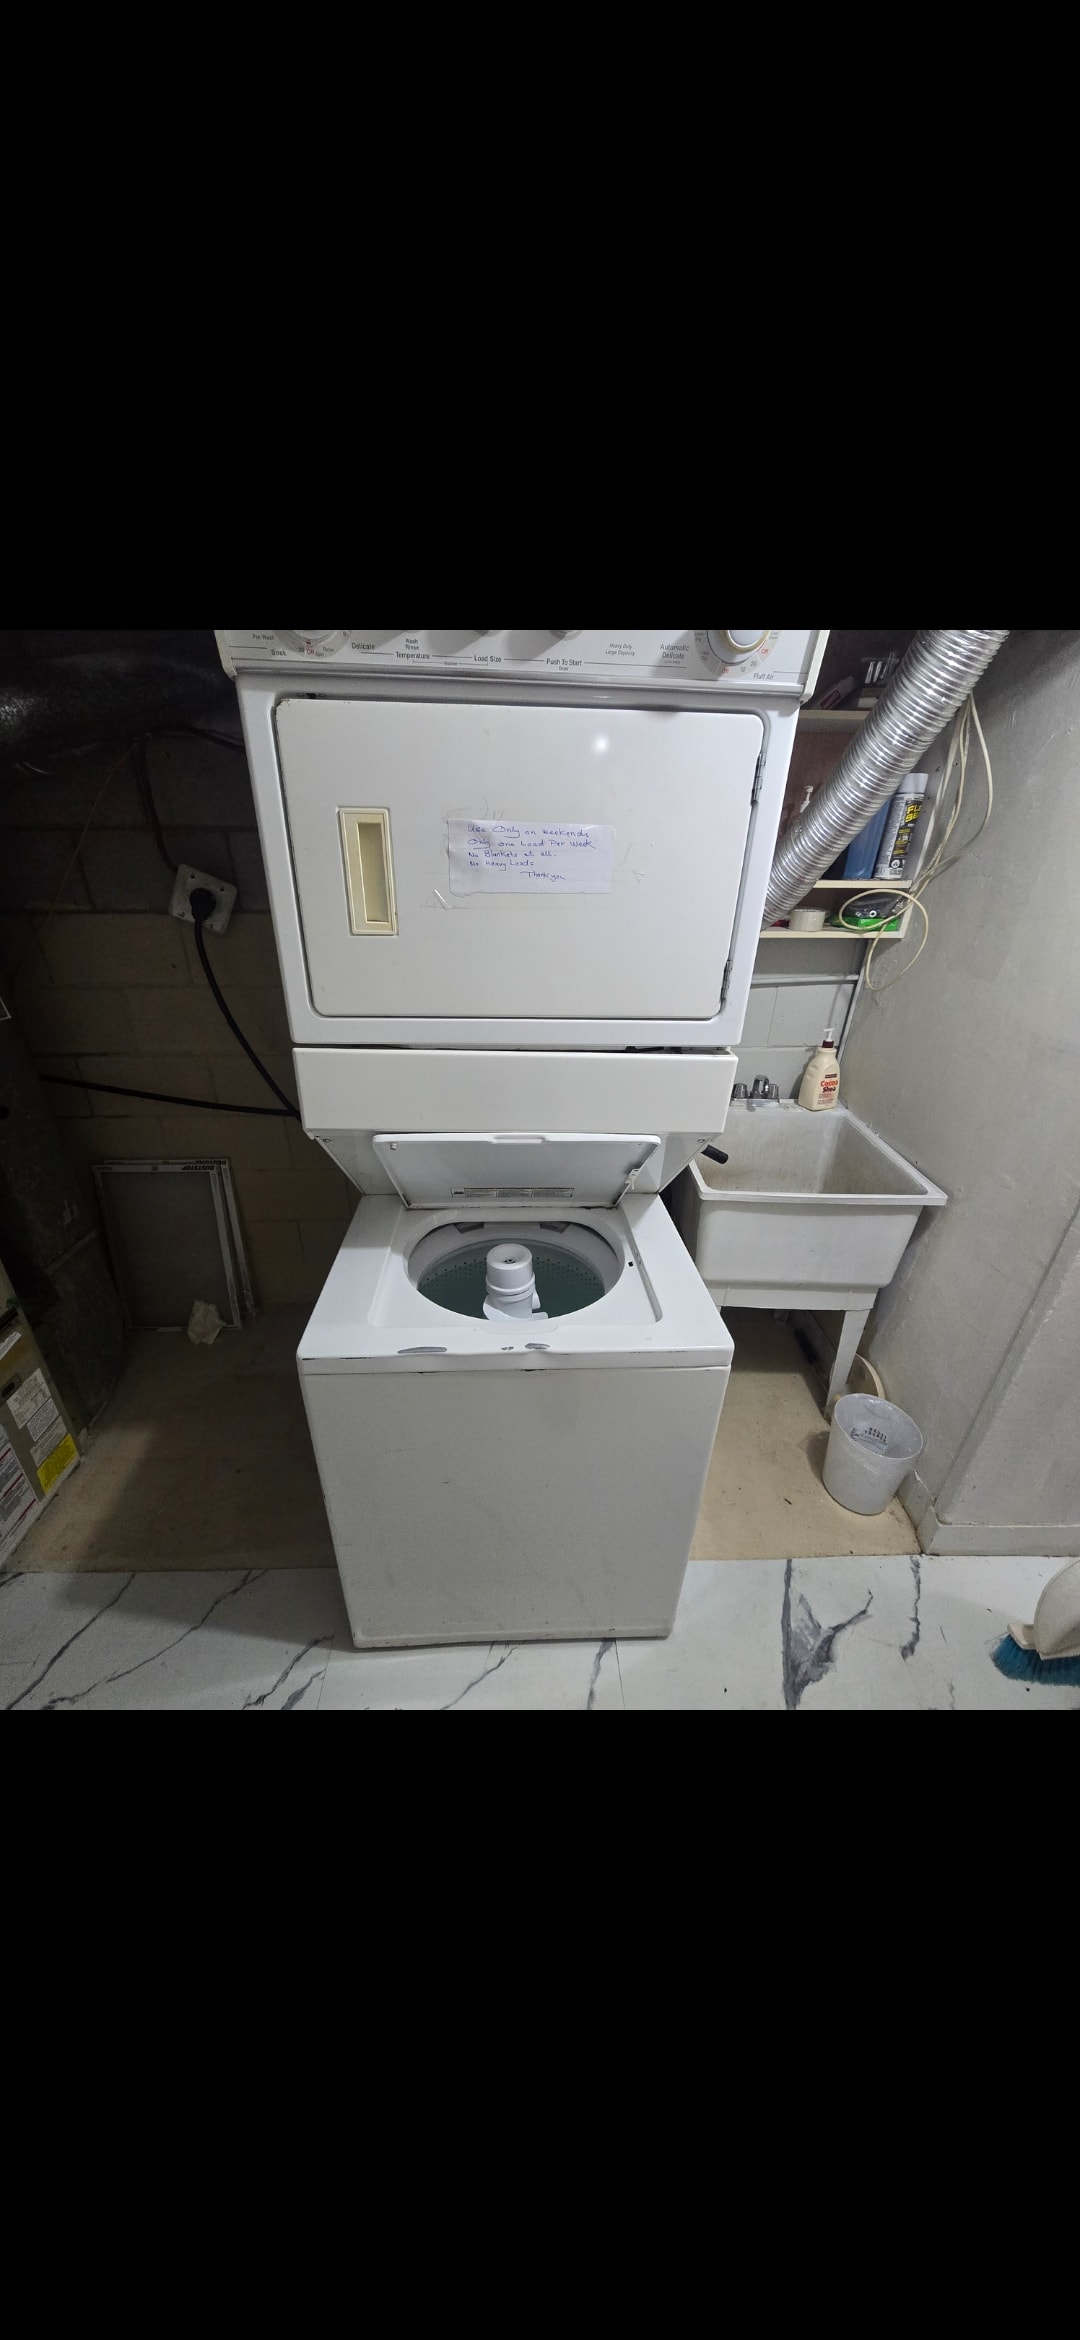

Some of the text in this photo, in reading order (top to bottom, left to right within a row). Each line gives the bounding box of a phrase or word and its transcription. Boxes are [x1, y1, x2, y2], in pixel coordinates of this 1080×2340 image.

[270, 648, 288, 656] Soak
[660, 644, 690, 652] Automatic
[396, 651, 430, 660] Temperature
[474, 654, 502, 663] Load Size
[662, 652, 685, 660] Delicate
[467, 824, 486, 834] Use
[492, 825, 520, 838] Only
[467, 838, 490, 849] Only
[521, 840, 545, 848] Load
[570, 840, 596, 849] Week
[520, 871, 550, 879] Thank
